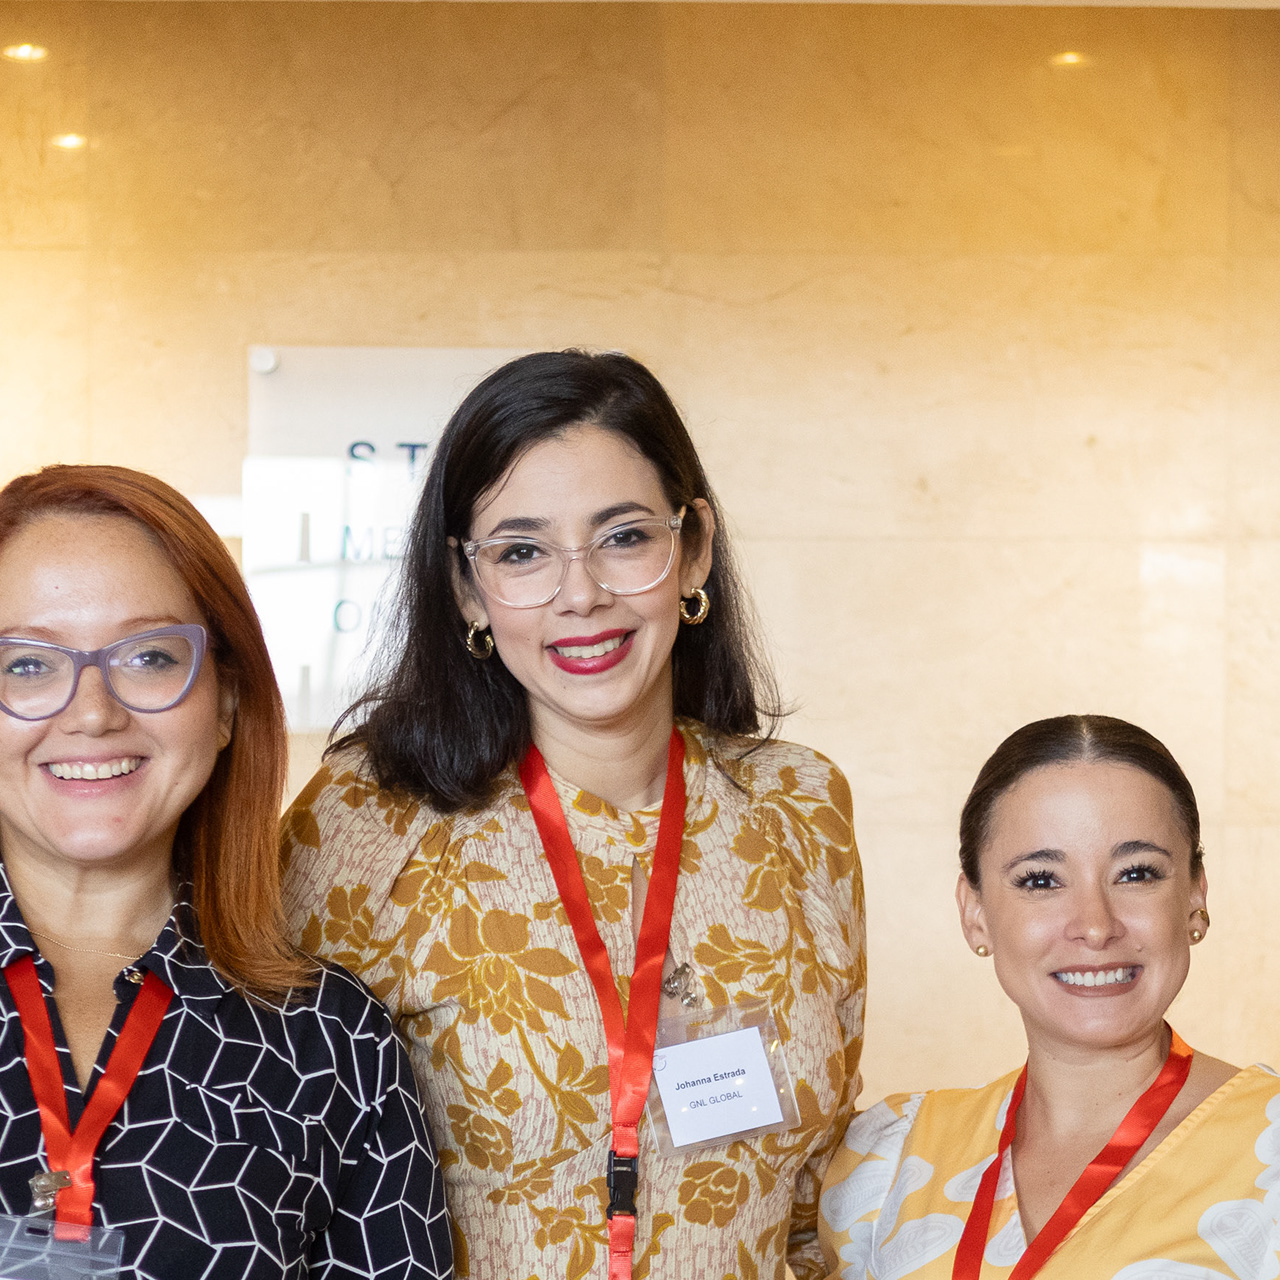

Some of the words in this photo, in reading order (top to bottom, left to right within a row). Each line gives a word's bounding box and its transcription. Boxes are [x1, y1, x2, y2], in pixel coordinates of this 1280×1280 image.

[675, 1076, 712, 1091] Johanna
[713, 1067, 746, 1081] Estrada
[689, 1098, 708, 1109] GNL
[708, 1090, 743, 1104] GLOBAL
